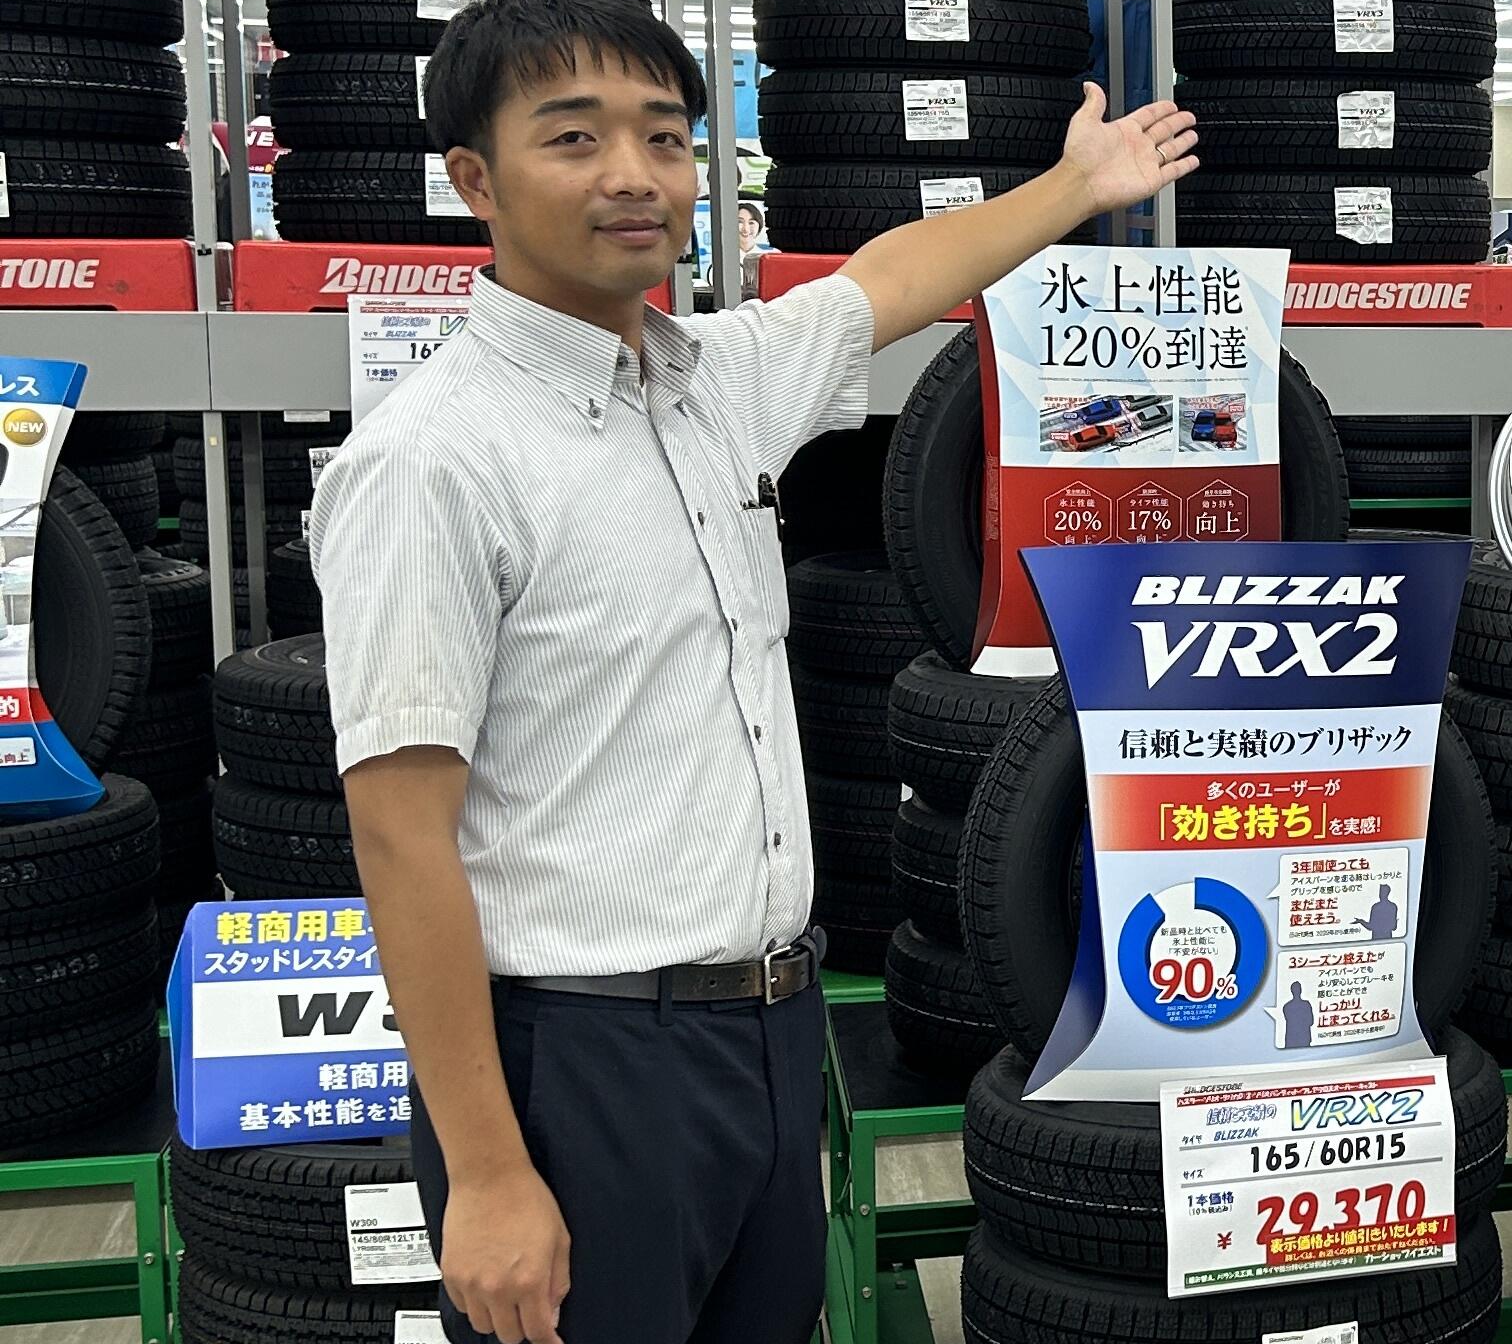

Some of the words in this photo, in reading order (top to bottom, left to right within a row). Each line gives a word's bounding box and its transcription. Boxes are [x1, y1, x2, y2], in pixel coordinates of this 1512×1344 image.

[0, 258, 100, 289] TONE
[319, 257, 475, 294] BRIDGE
[1039, 262, 1244, 317] 氷上性能
[1040, 325, 1249, 372] 120%到達
[6, 421, 44, 434] NEW
[1054, 510, 1102, 531] 20%
[1128, 510, 1171, 531] 17%
[1195, 512, 1240, 534] 向上
[1131, 575, 1405, 606] BLIZZAK
[1131, 611, 1400, 691] VRX2
[1118, 724, 1412, 761] 信頼と実績のブリザック
[1207, 778, 1341, 801] 多くのユーザーが
[1291, 857, 1371, 873] 3年間使っても
[1291, 898, 1339, 911] まだまだ
[216, 908, 373, 945] 軽商用車
[1290, 911, 1341, 926] 使えそう。
[1161, 925, 1227, 936] 新品時と比べても
[1172, 936, 1215, 946] 氷上性能に
[1289, 950, 1386, 968] 3シーズン終えたが
[1153, 957, 1235, 1000] 90%
[1319, 998, 1361, 1013] しっかり
[1317, 1008, 1396, 1027] 止まってくれる。
[319, 1061, 408, 1091] 軽商用
[1291, 1089, 1423, 1131] VRX2
[1213, 1127, 1260, 1142] BLIZZAK
[1250, 1132, 1406, 1174] 165/60R15
[1183, 1167, 1204, 1180] サイズ
[1187, 1191, 1235, 1207] 1本価格
[350, 1218, 378, 1227] W300
[1270, 1217, 1449, 1254] 表示価格より値引きいたします!
